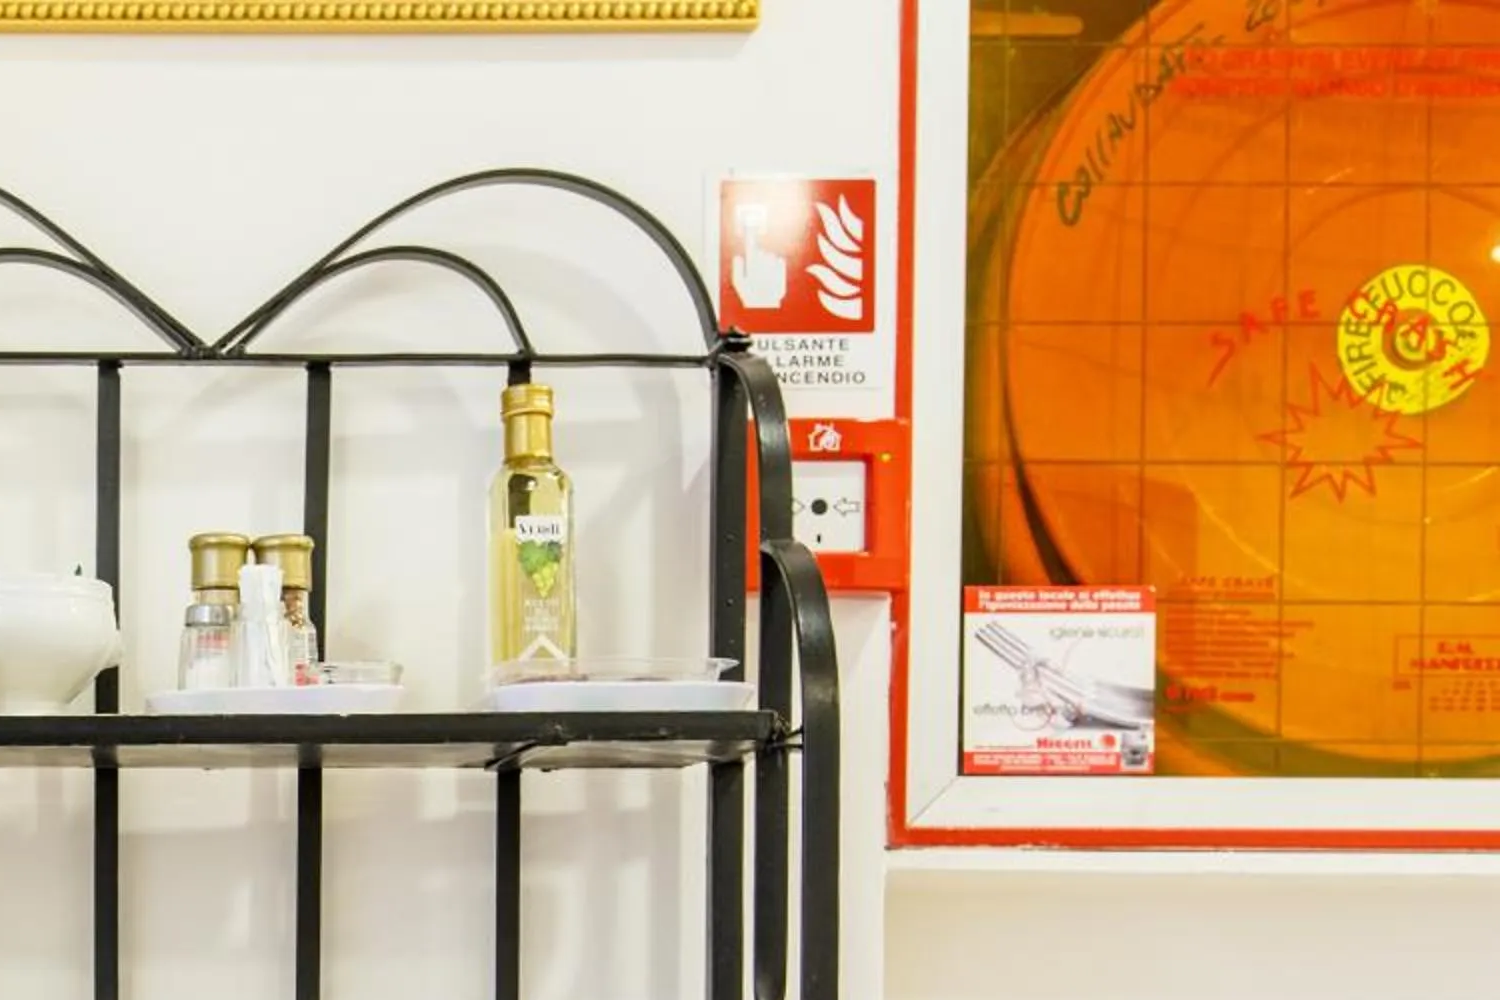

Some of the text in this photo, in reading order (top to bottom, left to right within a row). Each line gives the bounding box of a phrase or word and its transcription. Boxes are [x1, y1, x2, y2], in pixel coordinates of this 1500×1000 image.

[751, 337, 851, 351] ULSANTE
[775, 354, 845, 368] LARME
[775, 370, 866, 385] NCENDIO
